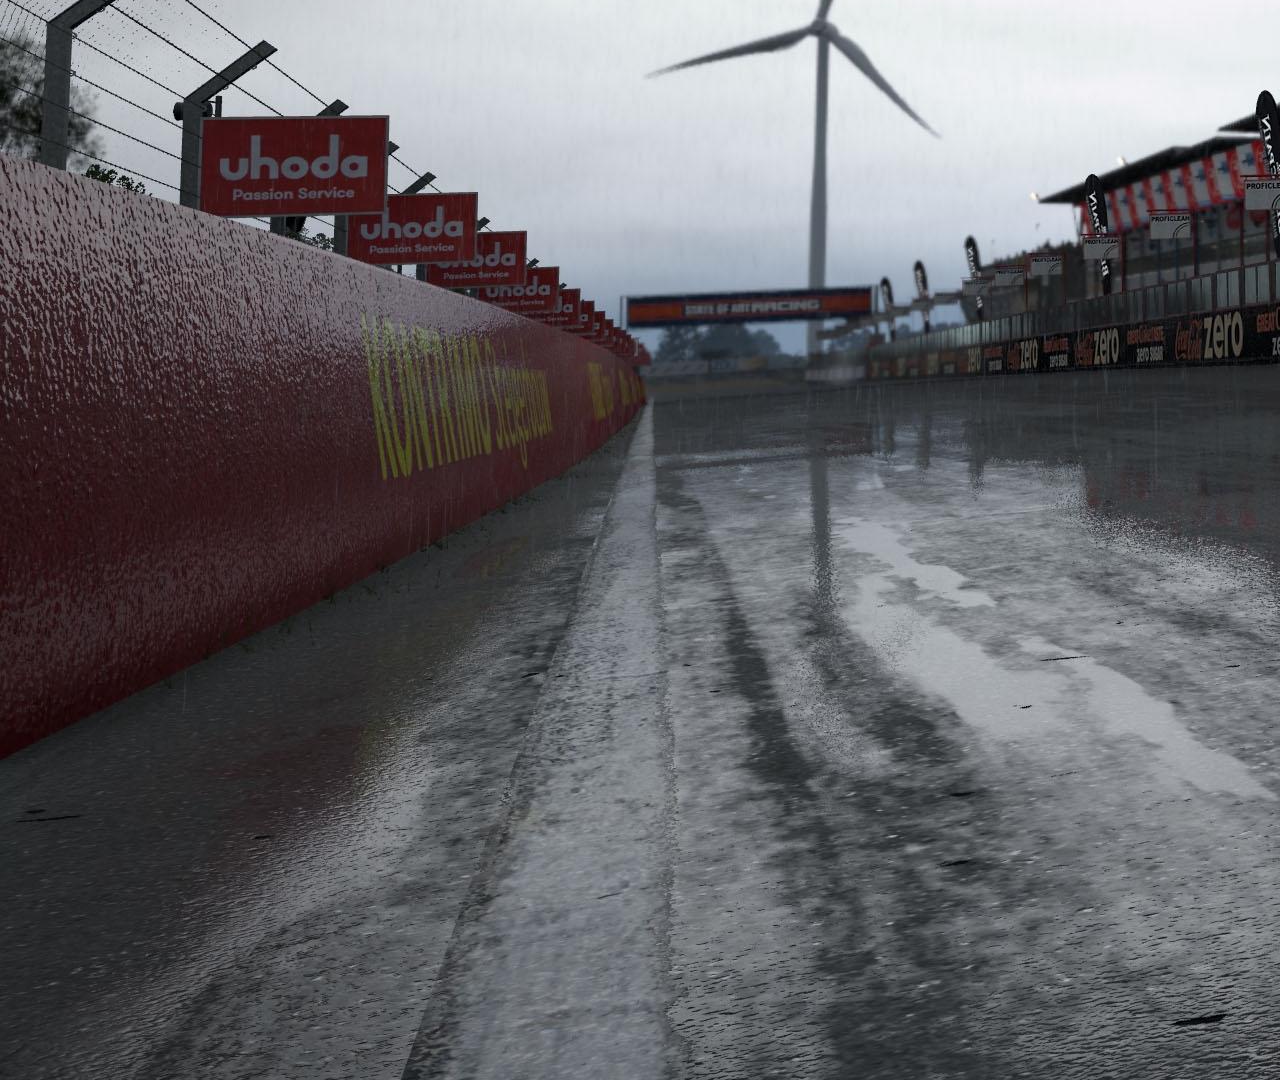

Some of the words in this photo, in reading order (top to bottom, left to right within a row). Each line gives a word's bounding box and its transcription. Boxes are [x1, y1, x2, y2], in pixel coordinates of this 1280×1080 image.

[219, 134, 369, 182] uhoda
[232, 188, 293, 202] Passion
[298, 186, 355, 201] Service
[360, 205, 464, 240] uhoda
[369, 244, 412, 255] Passion
[415, 242, 455, 253] Service
[436, 241, 517, 268] oda
[1094, 327, 1120, 366] zero
[1203, 311, 1244, 360] zero
[1020, 338, 1039, 370] zero
